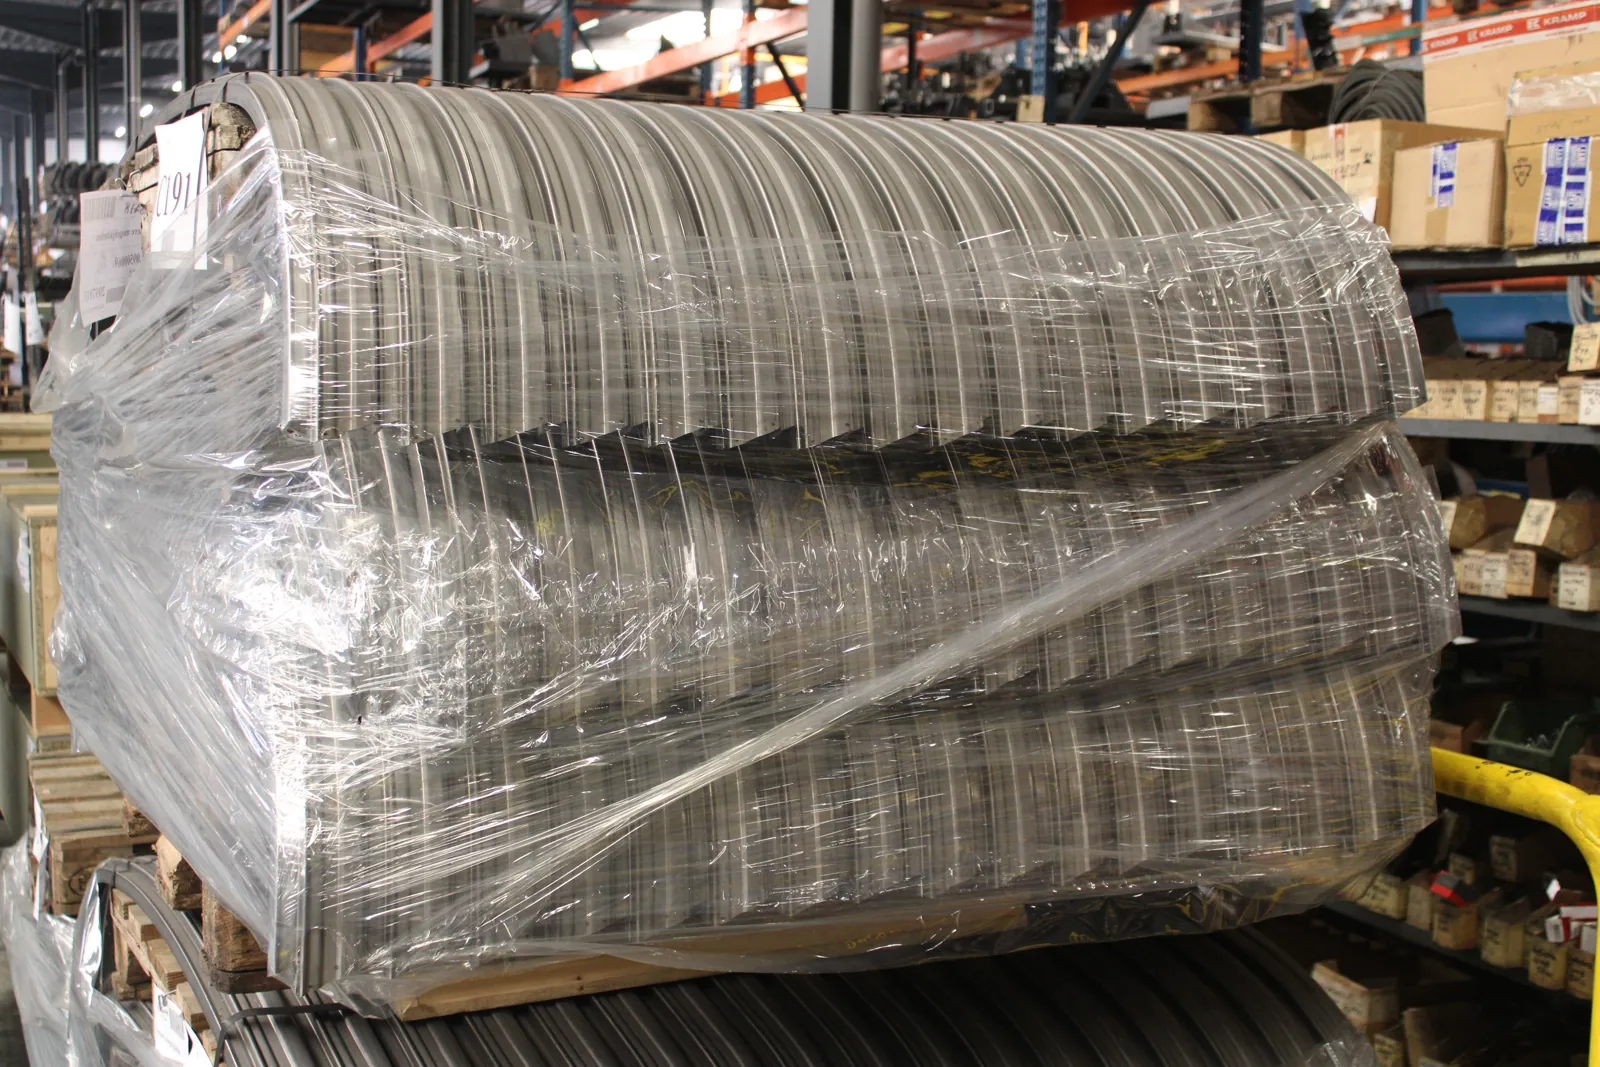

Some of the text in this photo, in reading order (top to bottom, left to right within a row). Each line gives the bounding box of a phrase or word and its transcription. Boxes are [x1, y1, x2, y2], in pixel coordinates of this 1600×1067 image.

[1543, 12, 1587, 26] KRAMP
[1479, 24, 1514, 37] KRAMP
[1430, 36, 1458, 48] KRAMP
[156, 171, 191, 217] C191
